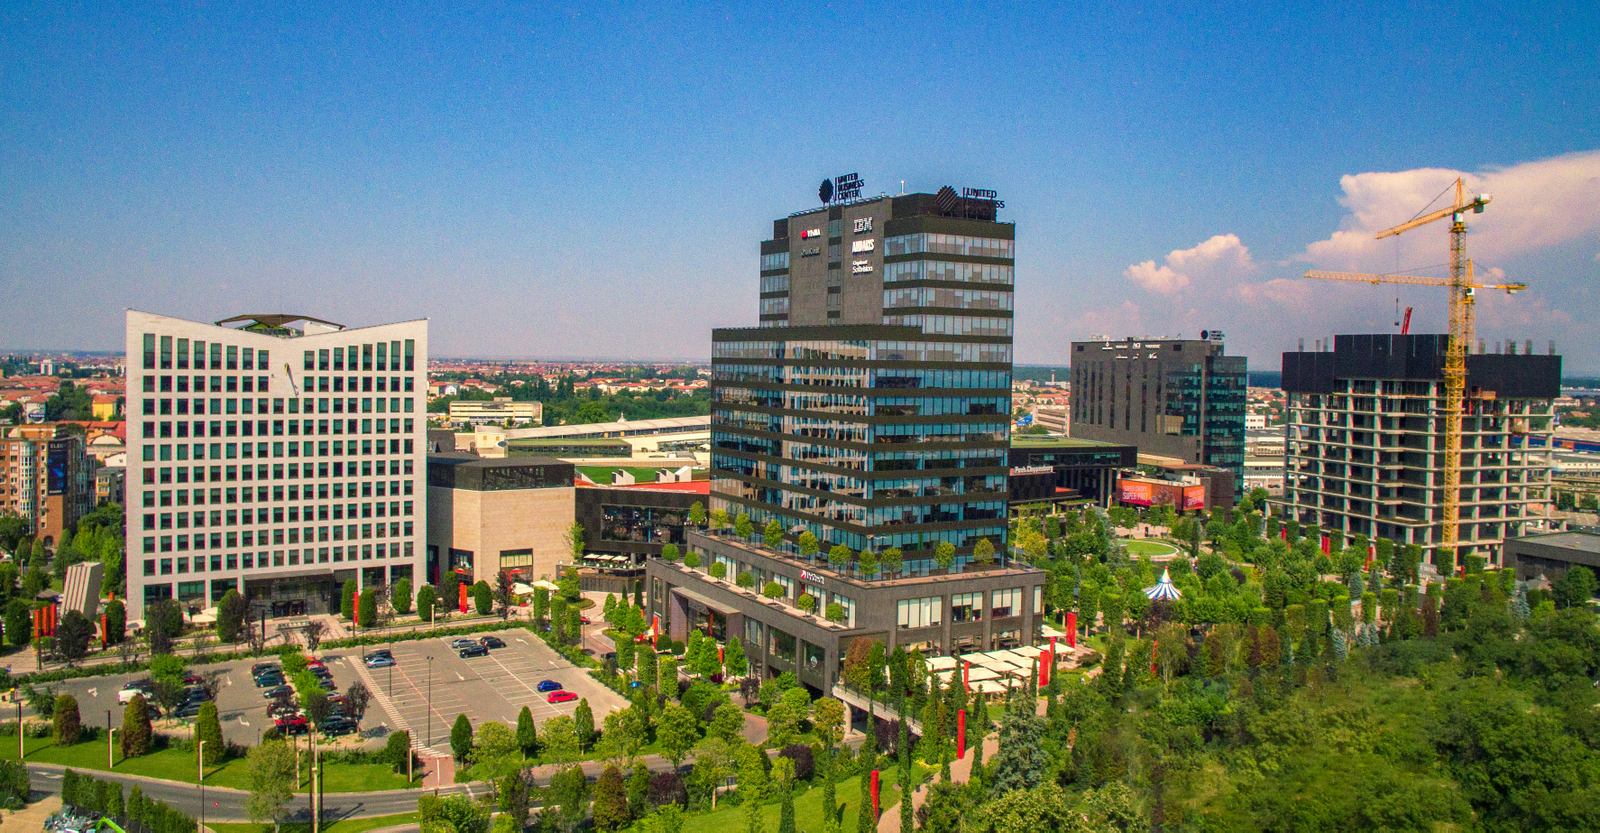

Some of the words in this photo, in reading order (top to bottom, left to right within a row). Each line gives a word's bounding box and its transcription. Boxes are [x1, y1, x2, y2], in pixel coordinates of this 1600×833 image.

[837, 172, 859, 183] UNITED
[837, 179, 865, 191] BUSINESS
[966, 187, 997, 199] UNITED
[853, 216, 873, 233] IBM
[1122, 491, 1137, 500] SUPER
